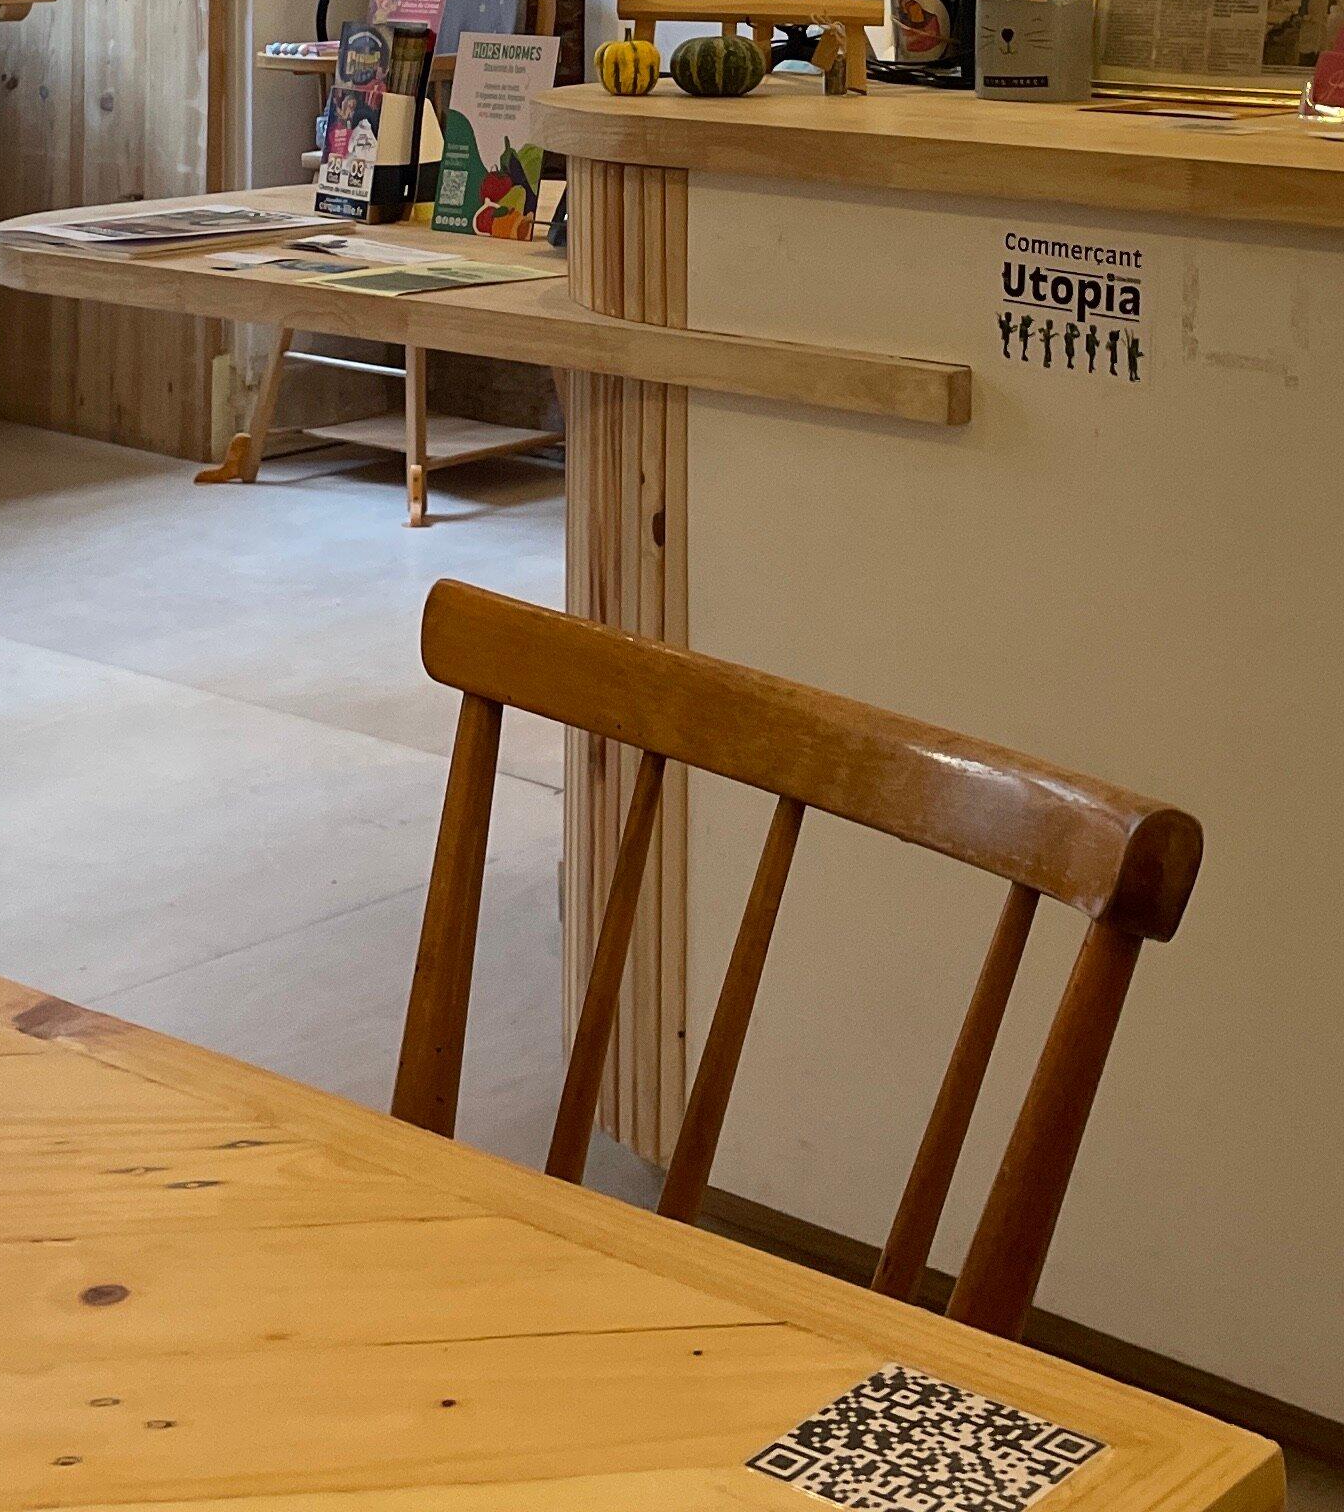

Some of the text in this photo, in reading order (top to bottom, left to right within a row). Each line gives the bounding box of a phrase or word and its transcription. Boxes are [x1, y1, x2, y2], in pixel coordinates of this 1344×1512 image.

[472, 42, 543, 61] HORS NORMES
[1005, 232, 1143, 269] Commerçant
[1002, 261, 1141, 323] Utopia
